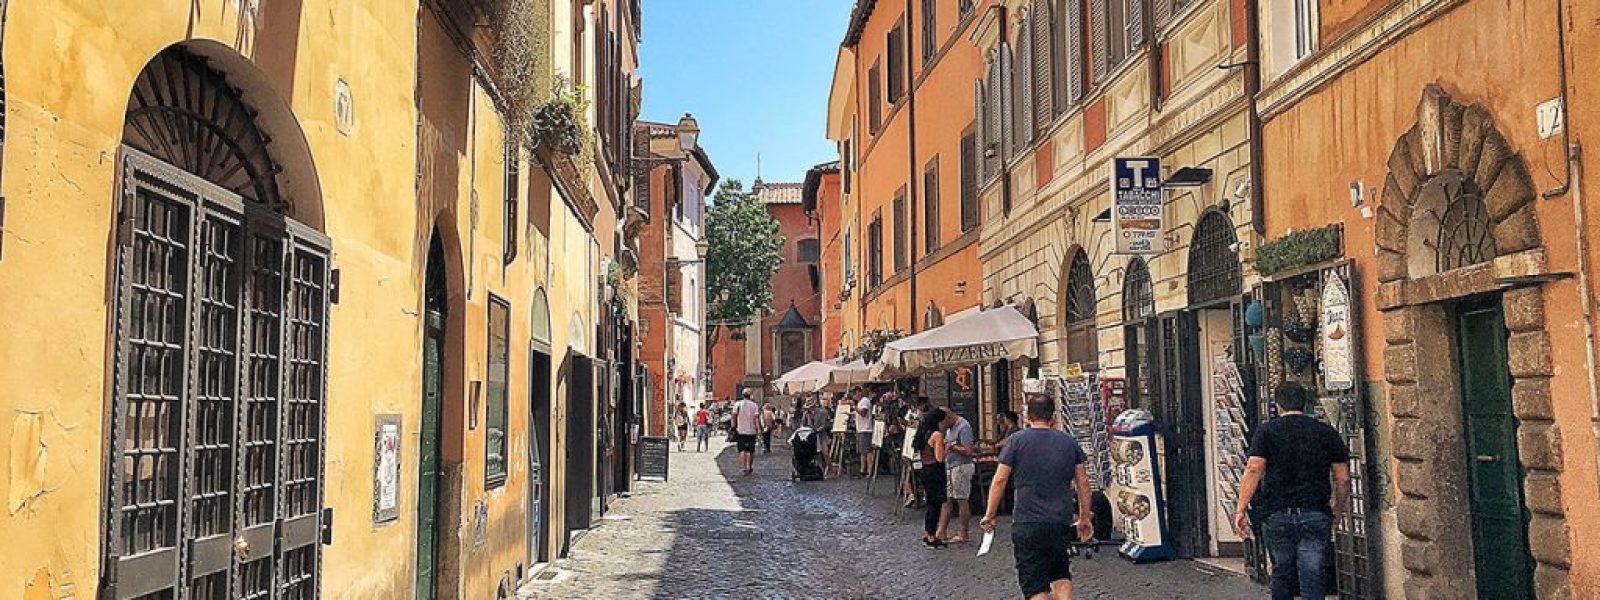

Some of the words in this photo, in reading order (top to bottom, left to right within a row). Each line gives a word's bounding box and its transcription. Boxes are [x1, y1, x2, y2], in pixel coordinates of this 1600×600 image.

[1540, 105, 1560, 133] 12
[1125, 160, 1150, 187] T
[1118, 190, 1161, 201] TABACCHI
[932, 343, 1009, 363] PIZZERIA
